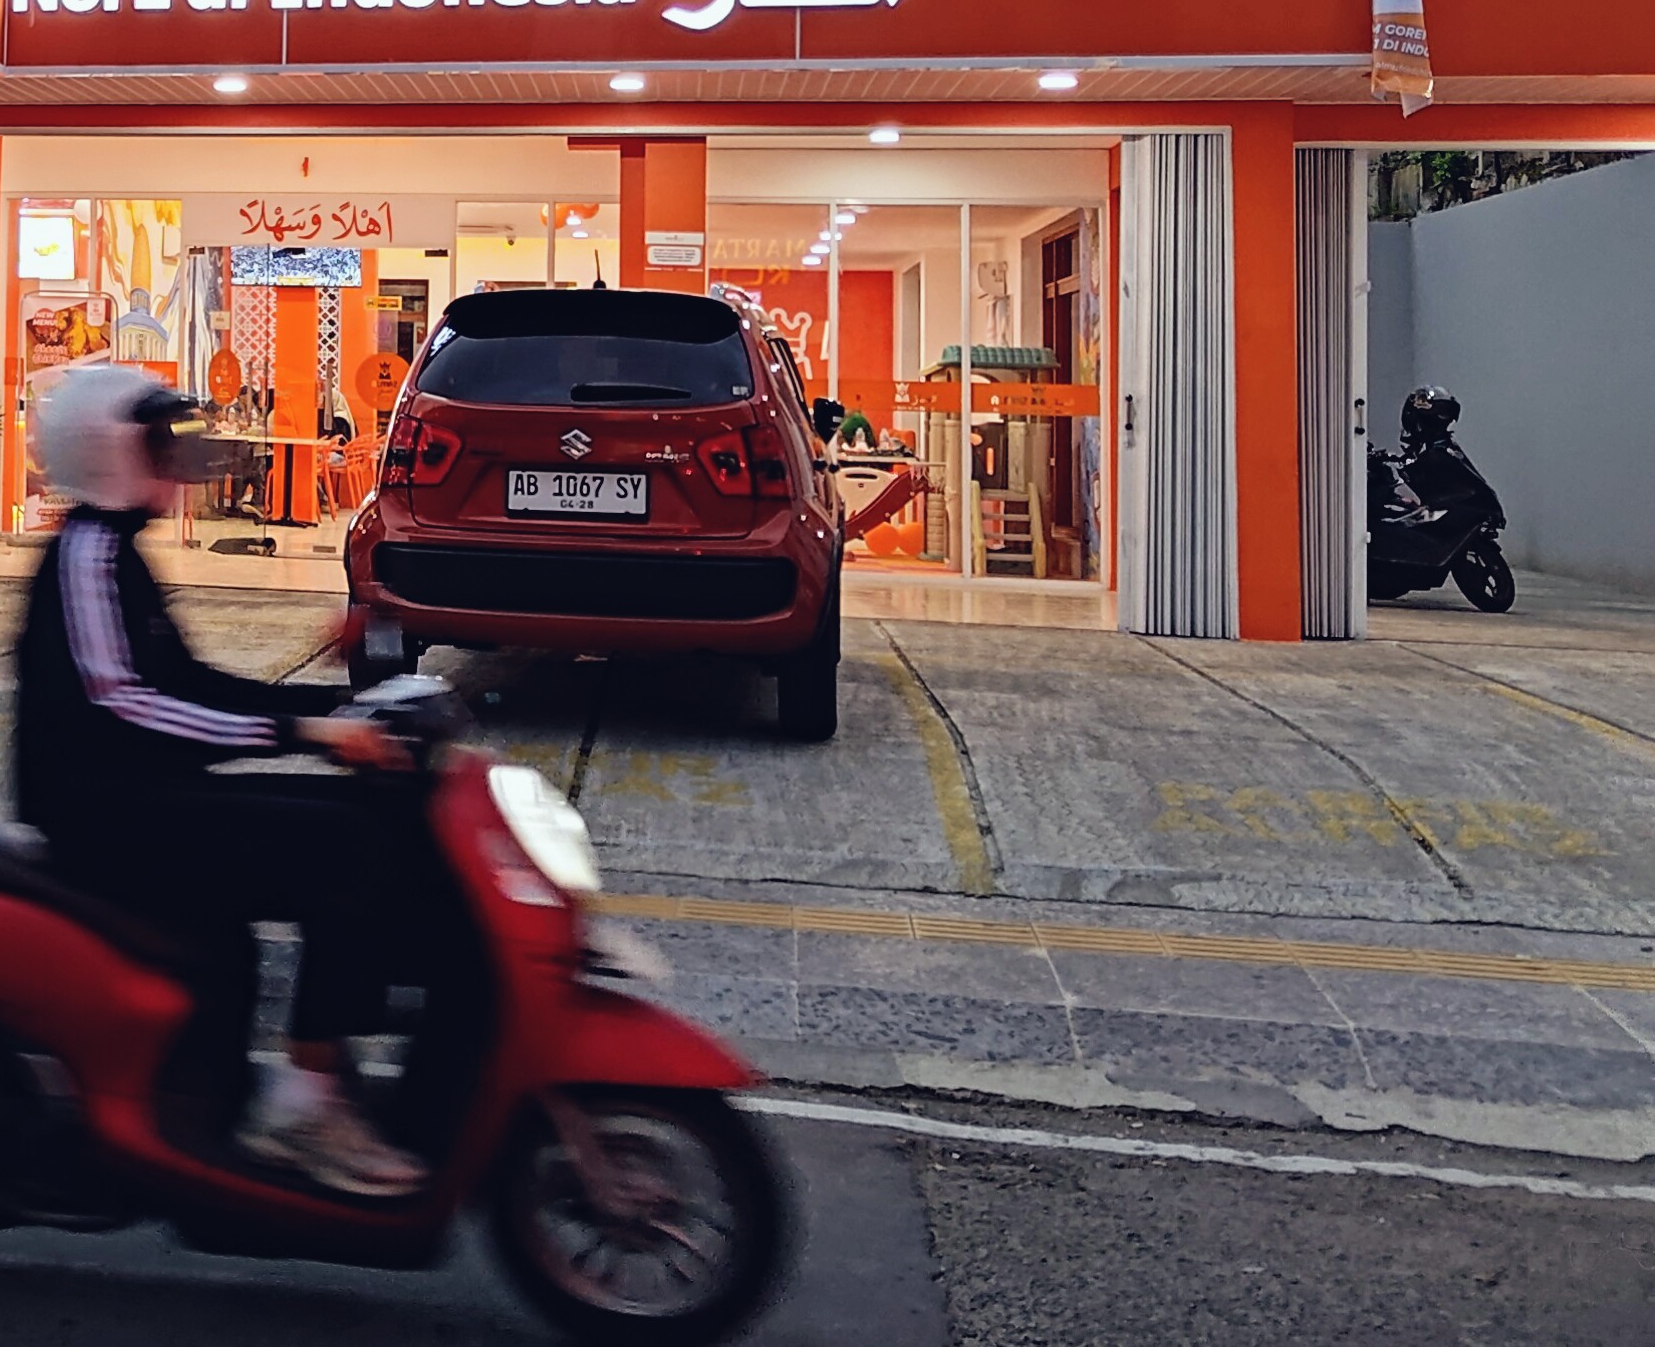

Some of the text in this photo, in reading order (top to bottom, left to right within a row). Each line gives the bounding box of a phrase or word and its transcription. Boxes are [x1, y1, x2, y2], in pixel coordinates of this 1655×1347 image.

[1382, 39, 1399, 51] DI
[513, 473, 642, 499] AB 1067 SY
